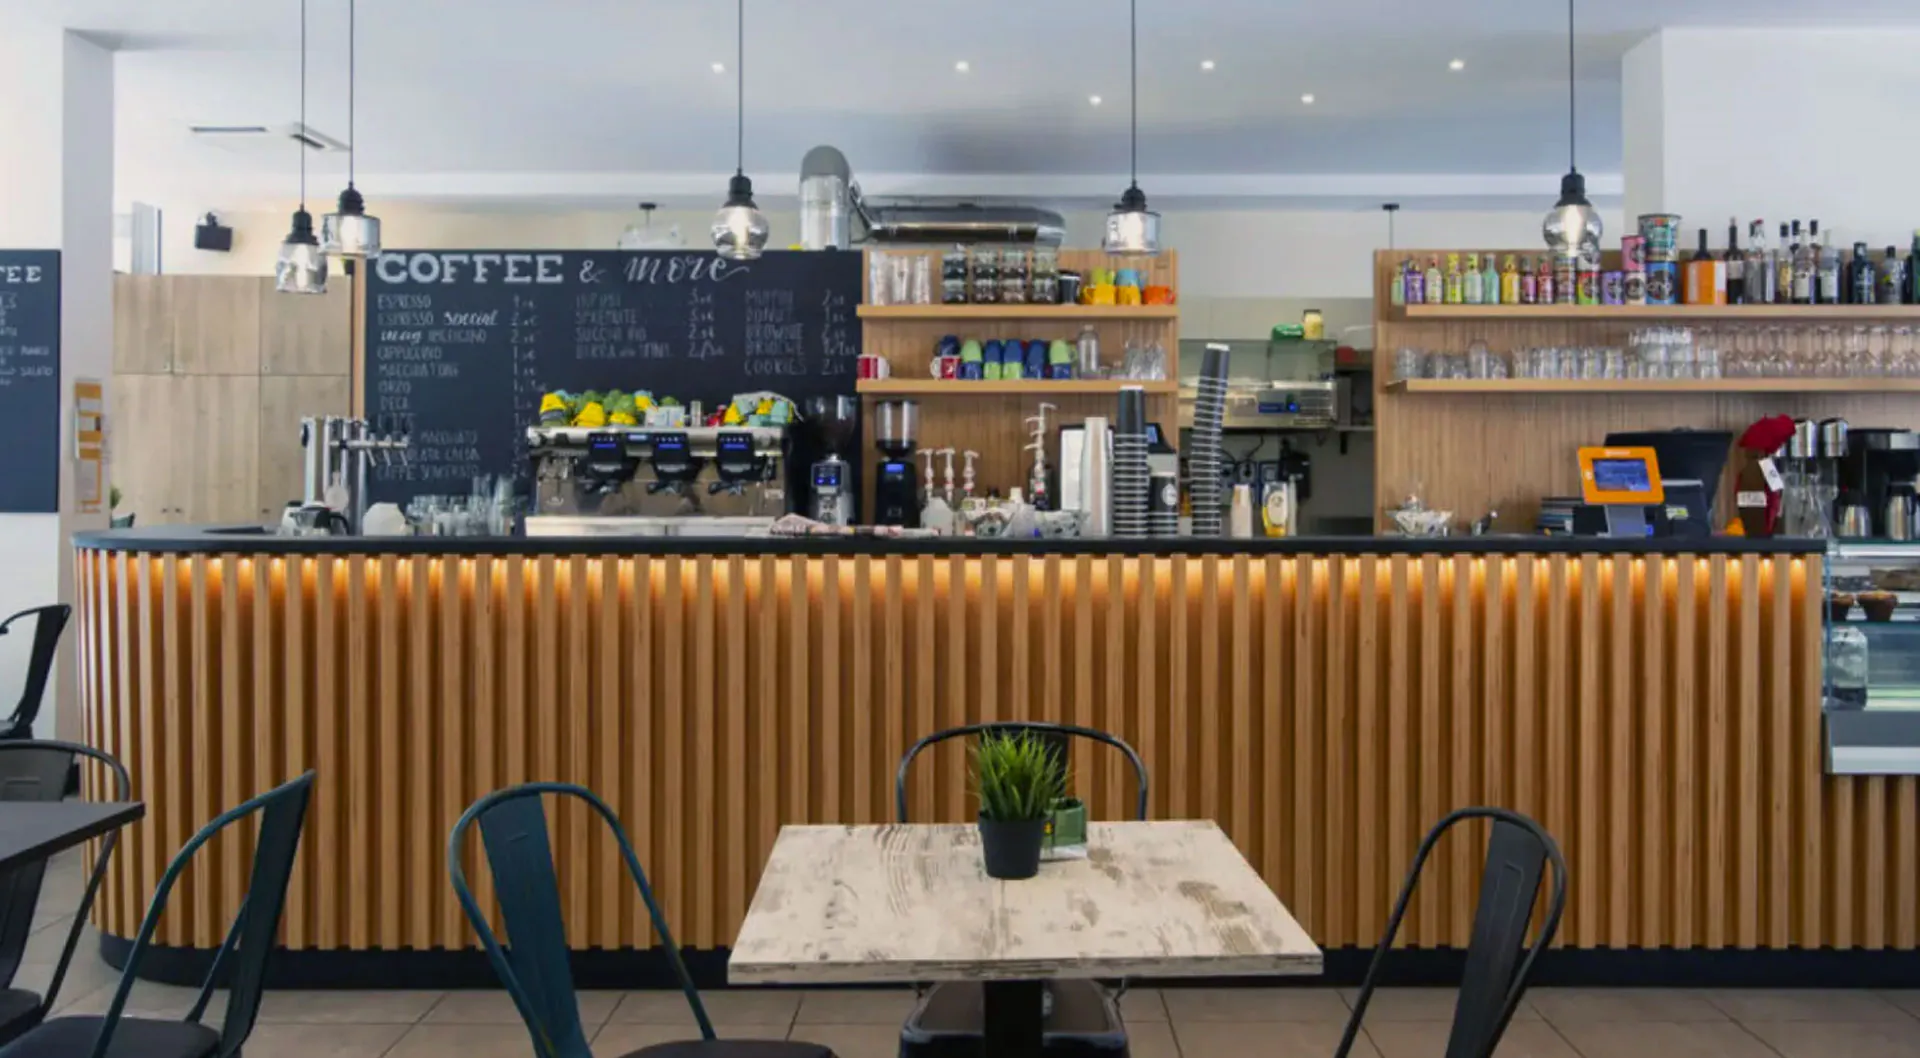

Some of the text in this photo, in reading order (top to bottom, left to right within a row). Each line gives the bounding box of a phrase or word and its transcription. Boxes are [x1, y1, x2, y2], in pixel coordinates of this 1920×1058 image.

[376, 253, 564, 284] COFFEE
[579, 259, 606, 284] &
[377, 294, 432, 309] ESPRESSO
[377, 310, 434, 325] ESPRESSO
